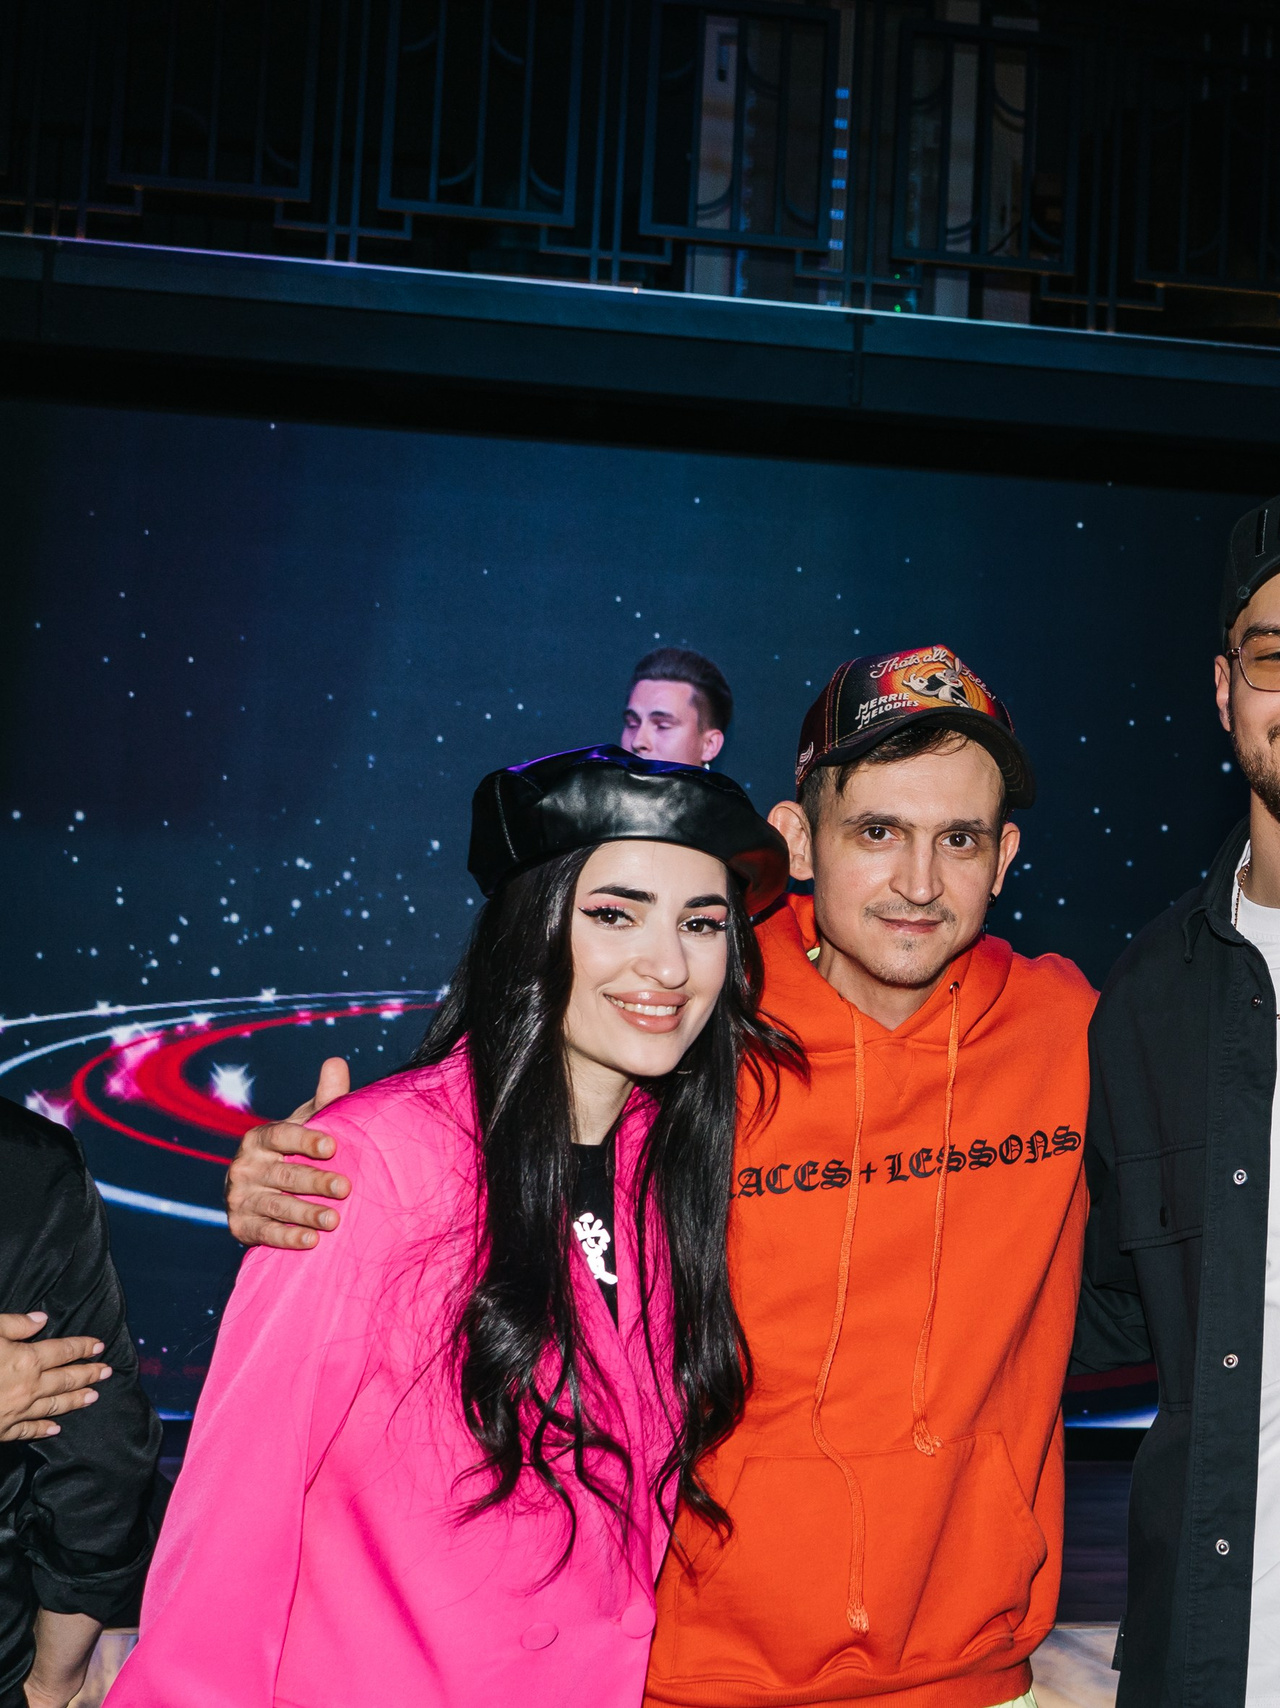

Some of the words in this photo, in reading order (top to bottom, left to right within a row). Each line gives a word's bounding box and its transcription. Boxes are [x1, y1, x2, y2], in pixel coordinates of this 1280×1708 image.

[855, 692, 910, 720] MERRIE
[857, 700, 920, 729] MELODIES
[729, 1159, 852, 1199] ACES
[884, 1125, 1082, 1185] LESSONS
